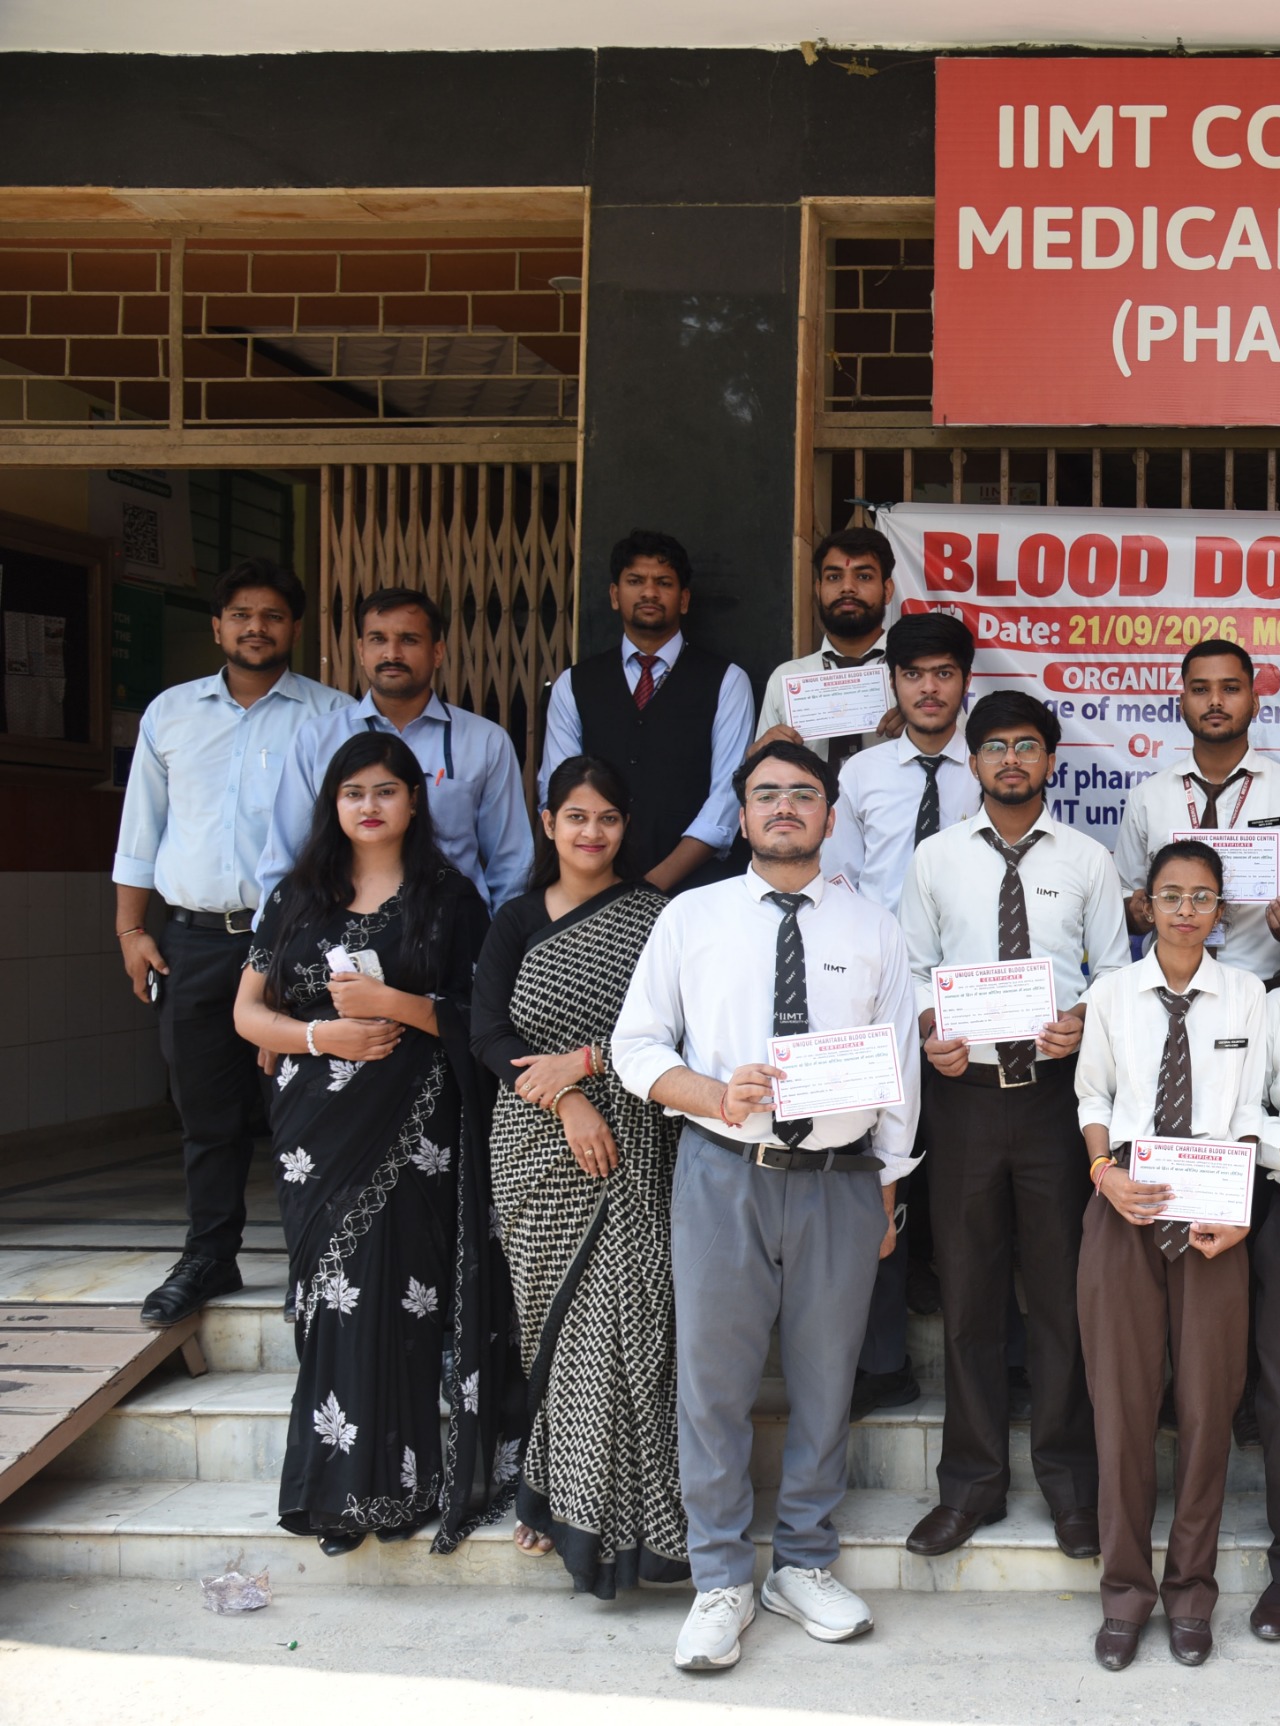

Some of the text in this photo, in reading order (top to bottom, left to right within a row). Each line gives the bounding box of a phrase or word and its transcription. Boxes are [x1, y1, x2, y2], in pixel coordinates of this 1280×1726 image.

[999, 105, 1169, 170] IIMT
[924, 531, 1169, 599] BLOOD
[978, 612, 1061, 646] Date:
[1069, 615, 1246, 649] 21/09/2026,
[1063, 667, 1183, 692] ORGANIZ
[1081, 696, 1110, 721] of
[1117, 697, 1182, 723] medi
[1128, 733, 1164, 758] Or
[1046, 762, 1068, 788] of
[1037, 888, 1059, 898] IIMT
[824, 963, 846, 973] IIMT
[975, 968, 1007, 976] CHARITABLE
